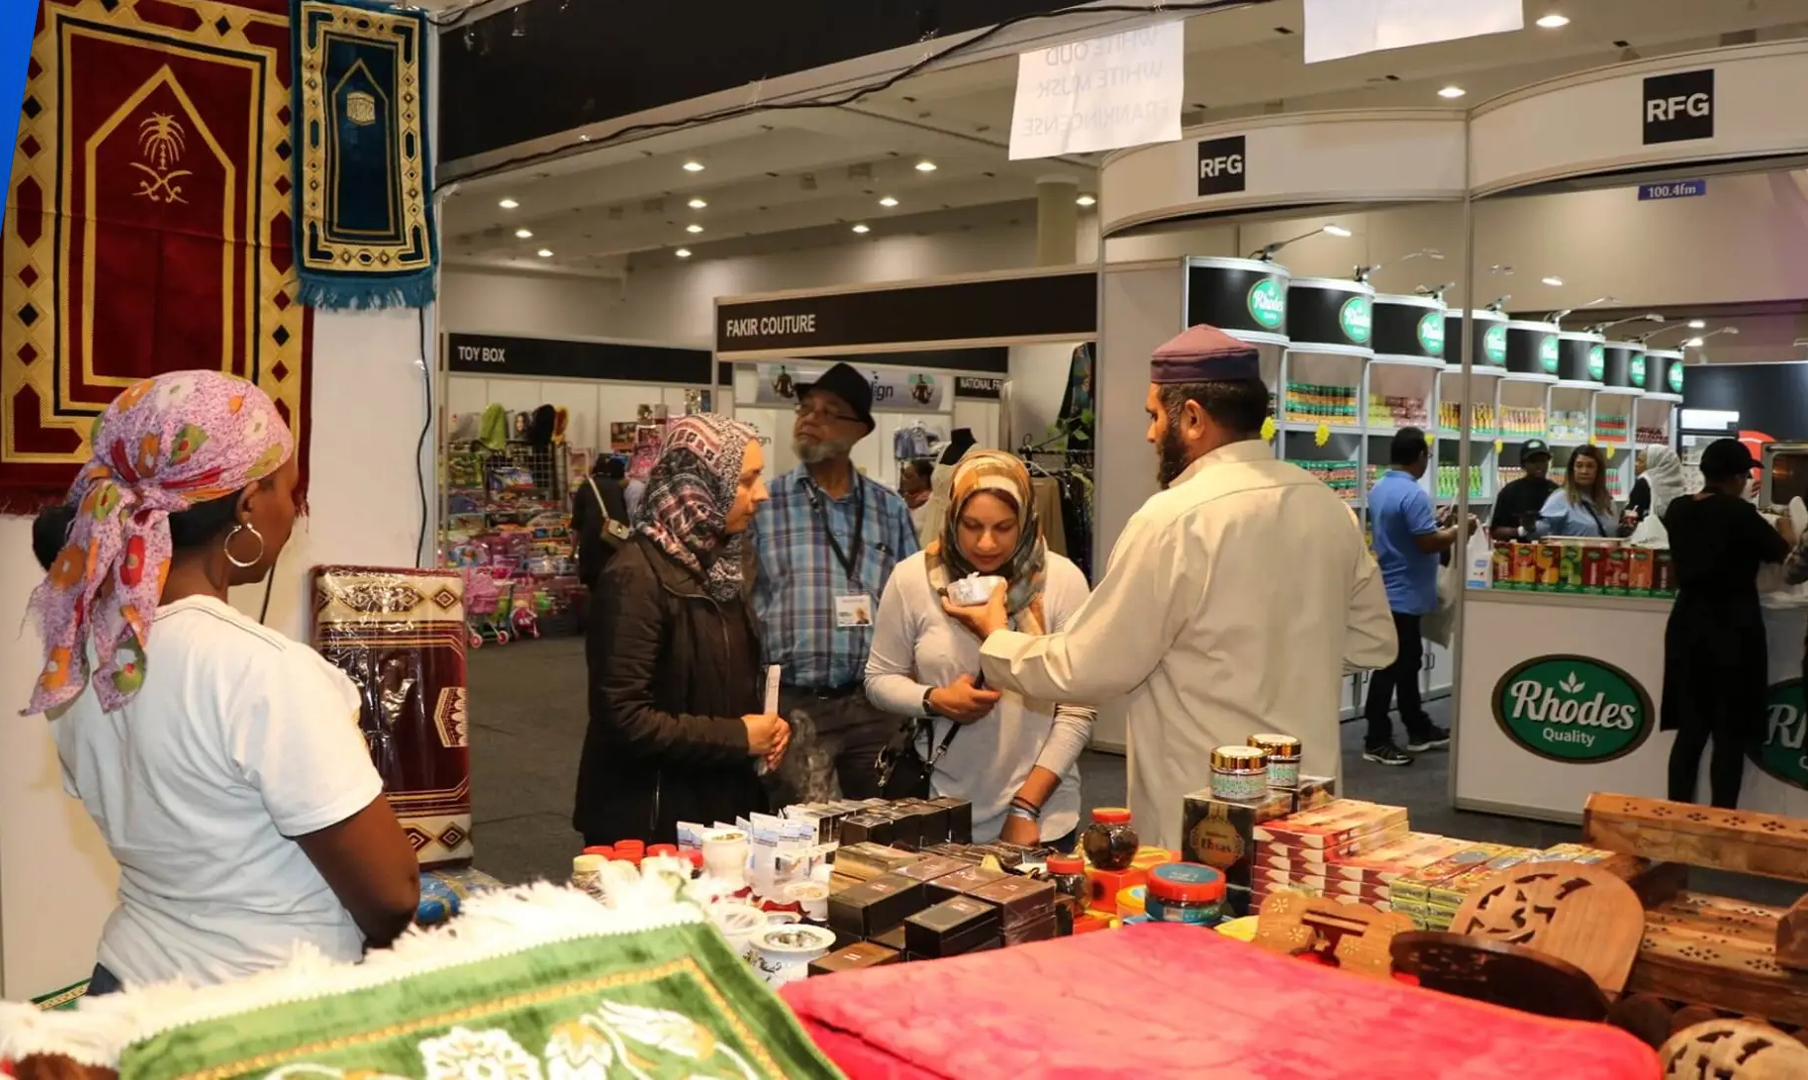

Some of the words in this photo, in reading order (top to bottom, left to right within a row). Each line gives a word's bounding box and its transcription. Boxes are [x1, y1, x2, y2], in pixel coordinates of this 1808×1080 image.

[1647, 92, 1710, 123] RFG
[1200, 154, 1243, 179] RFG
[1647, 183, 1697, 198] 100.4fm
[726, 318, 758, 337] FAKIR
[760, 314, 816, 335] COUTURE
[457, 345, 480, 361] TOY
[482, 347, 506, 362] BOX
[1510, 679, 1637, 730] Rhodes
[1542, 727, 1596, 747] Quality
